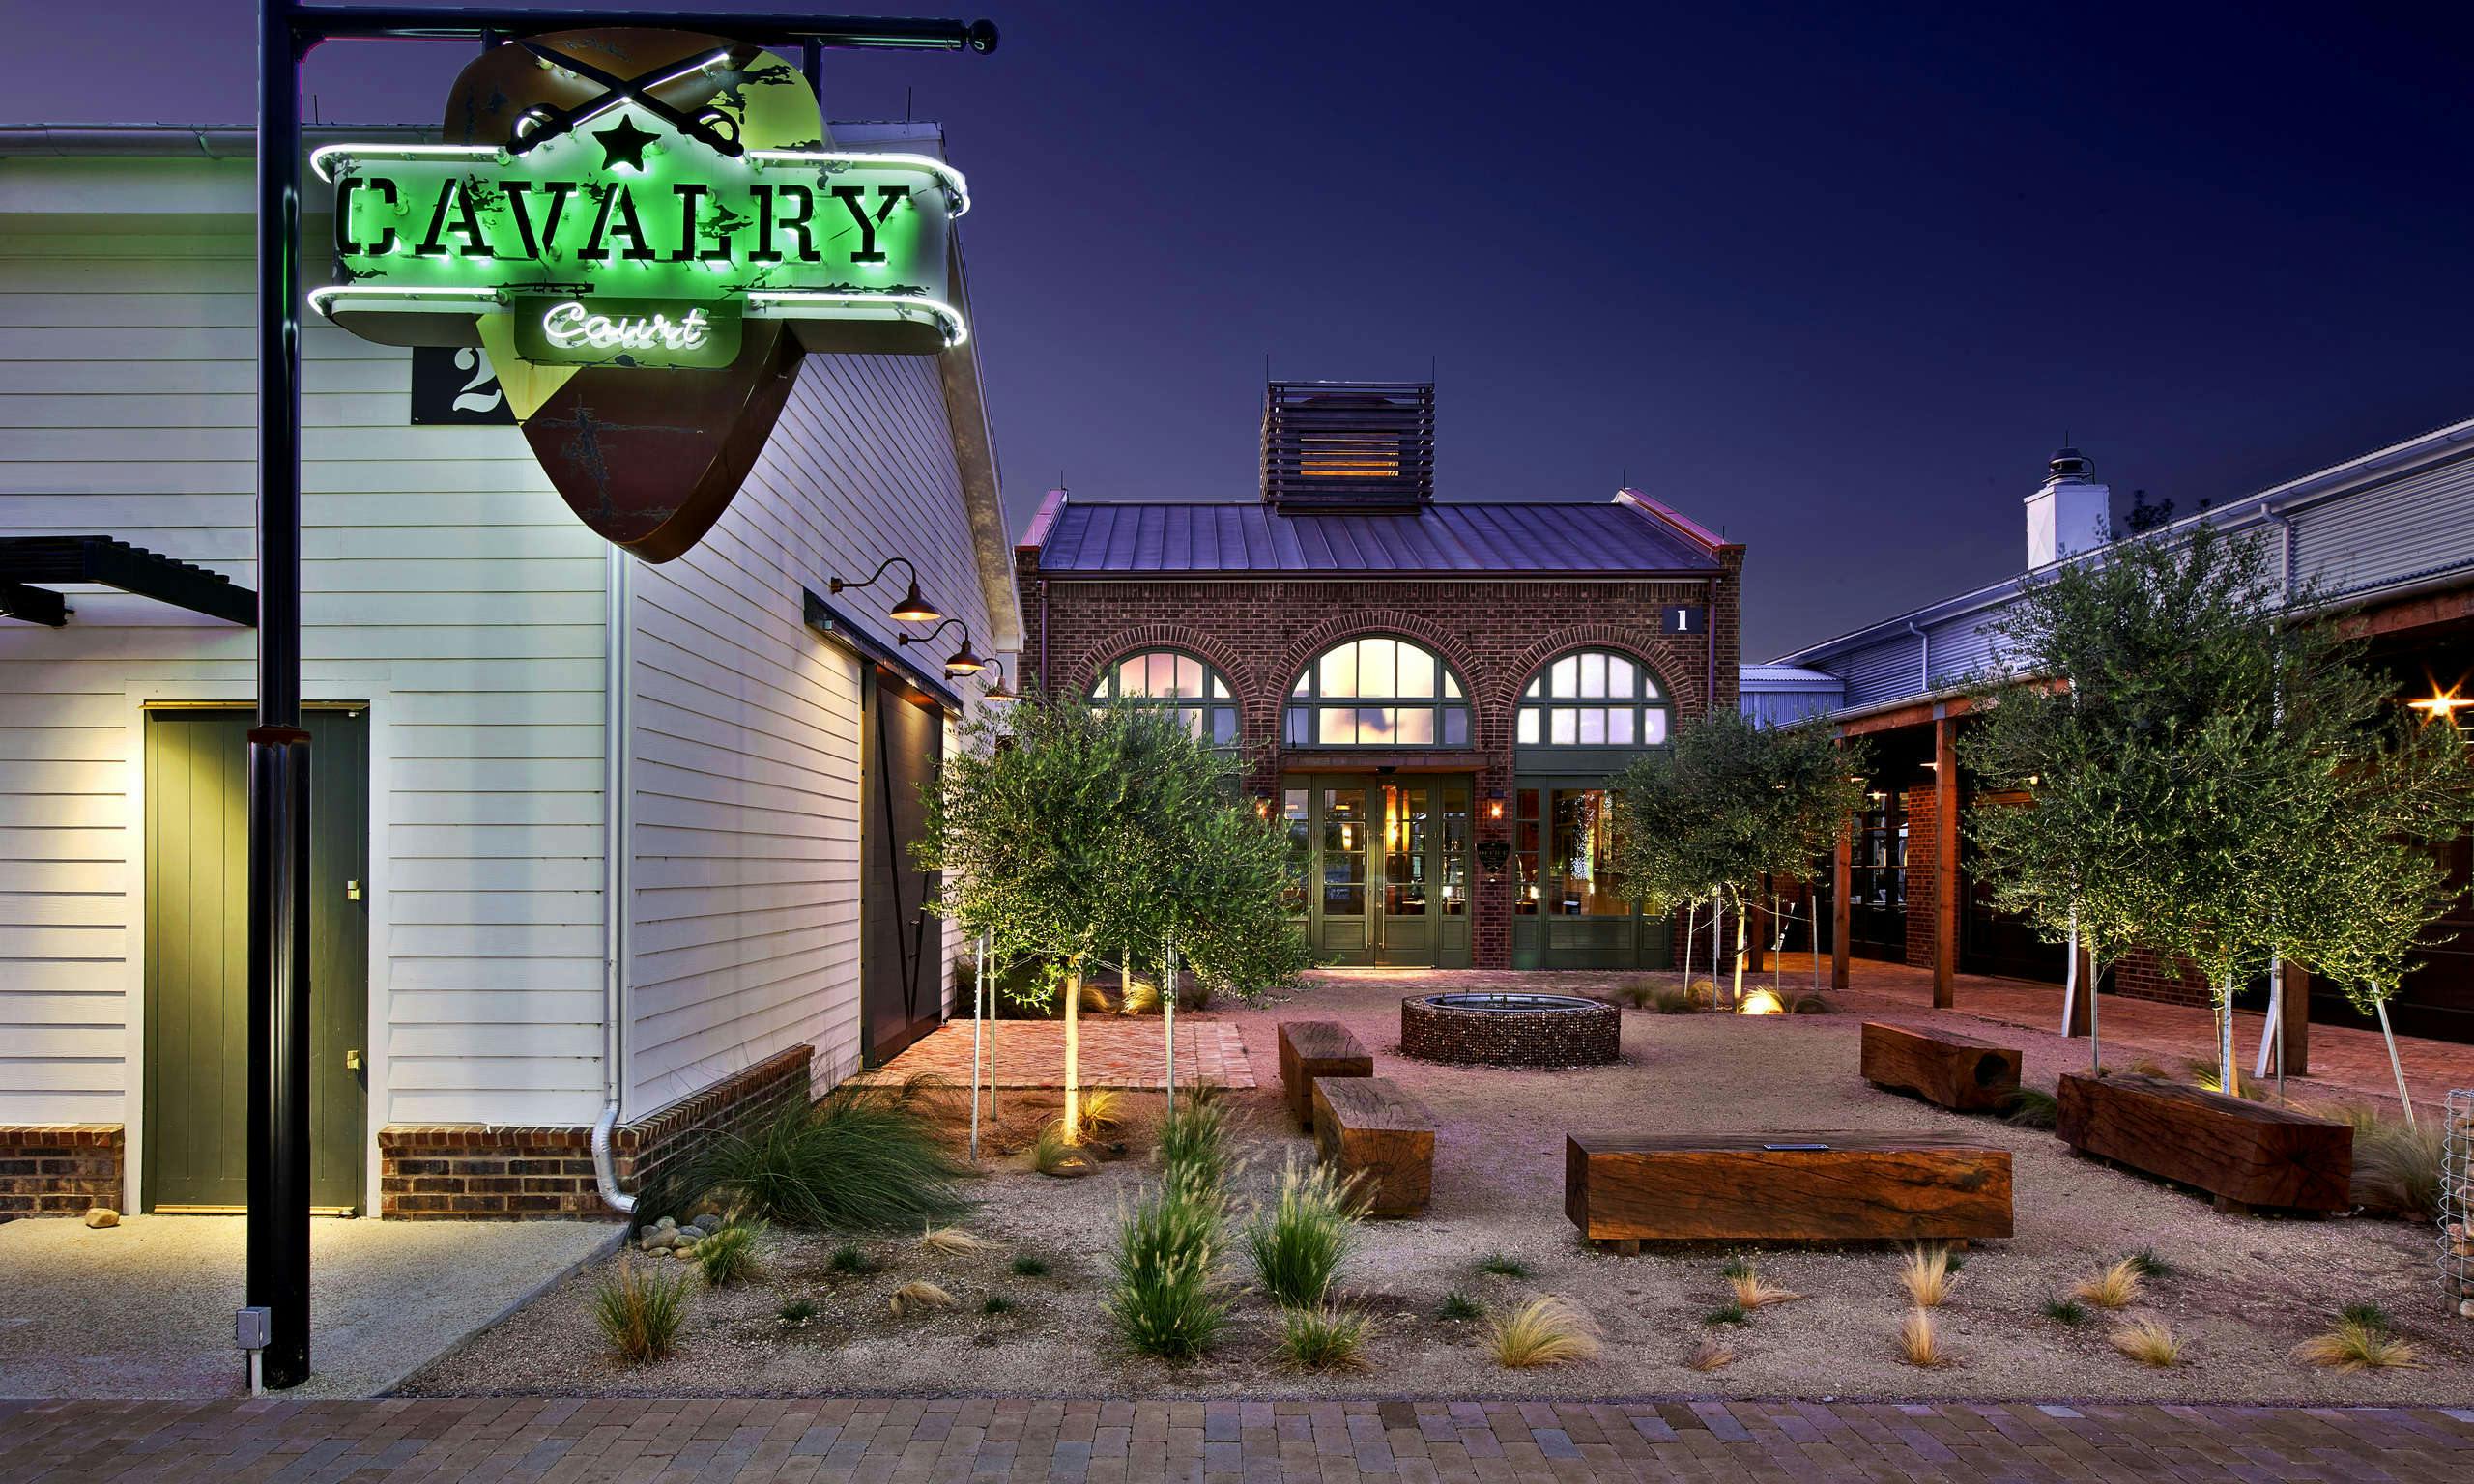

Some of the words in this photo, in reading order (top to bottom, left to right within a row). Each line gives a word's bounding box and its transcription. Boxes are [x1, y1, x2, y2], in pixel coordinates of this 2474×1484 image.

[336, 177, 910, 263] CAVALRY
[543, 301, 710, 348] Court
[452, 347, 502, 413] 2
[1677, 610, 1688, 631] 1
